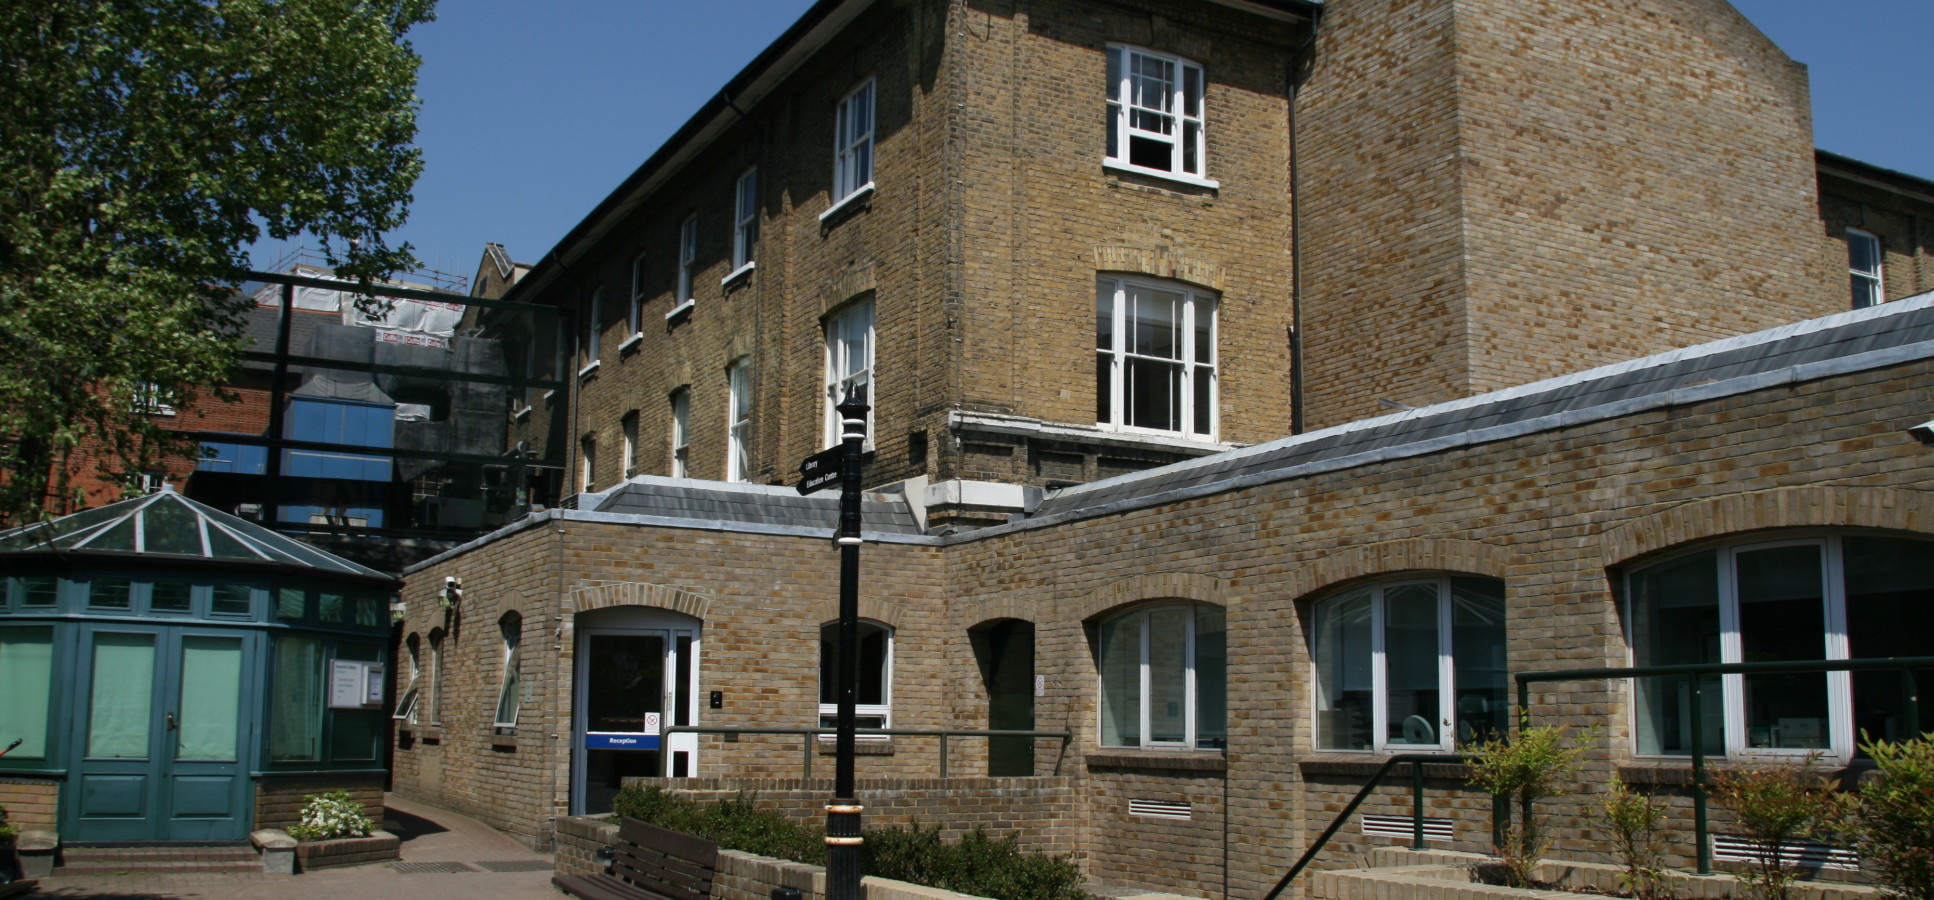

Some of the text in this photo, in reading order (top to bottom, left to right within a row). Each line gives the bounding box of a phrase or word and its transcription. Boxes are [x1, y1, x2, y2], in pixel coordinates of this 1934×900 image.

[806, 461, 818, 470] Library
[806, 472, 837, 488] Education Centre
